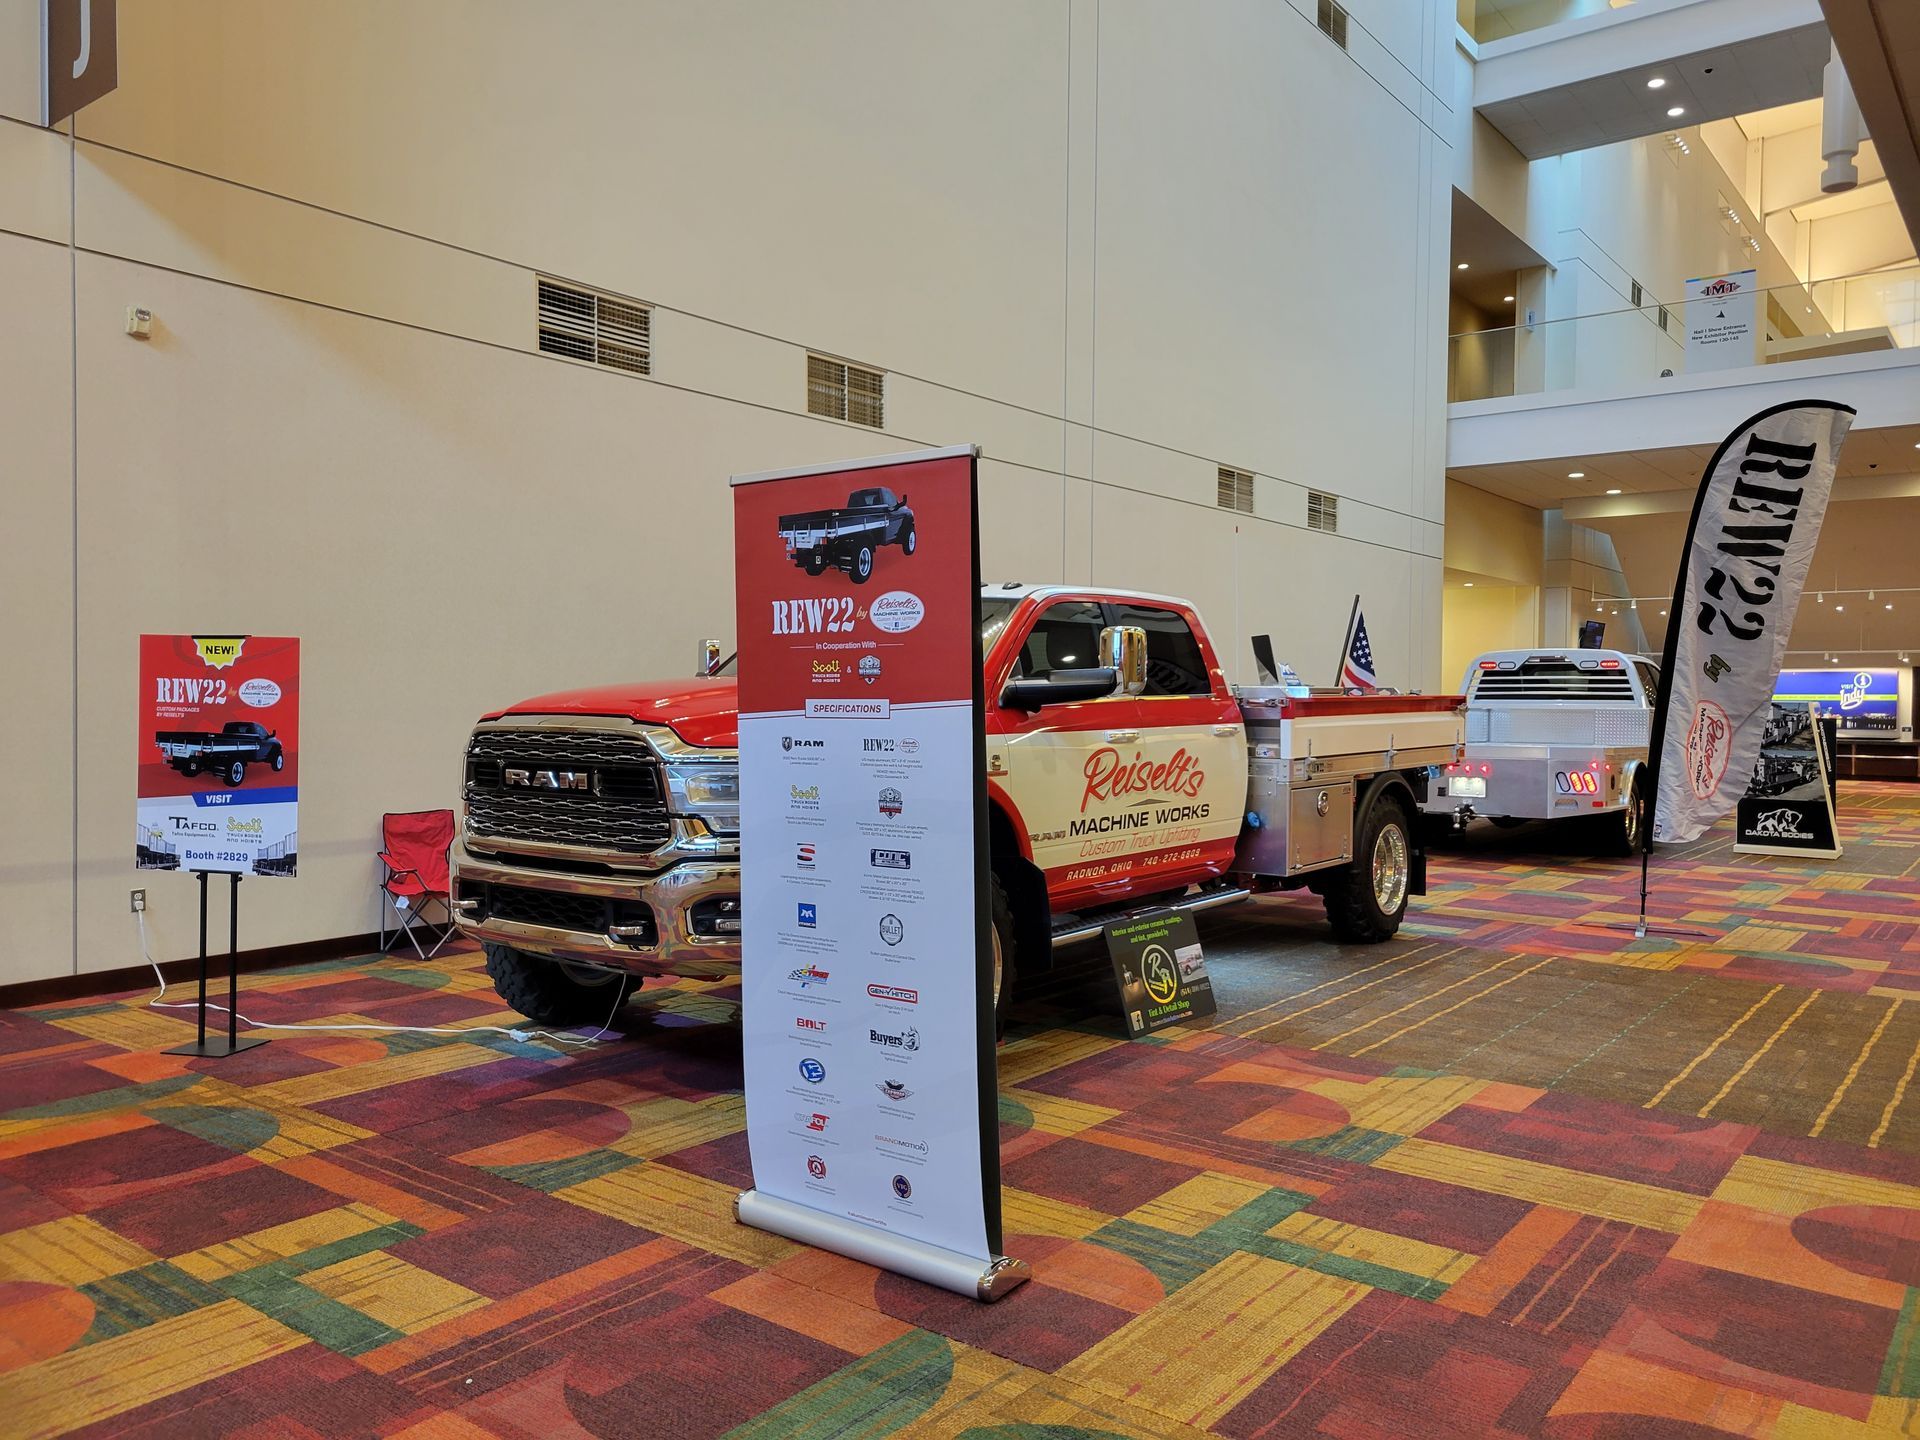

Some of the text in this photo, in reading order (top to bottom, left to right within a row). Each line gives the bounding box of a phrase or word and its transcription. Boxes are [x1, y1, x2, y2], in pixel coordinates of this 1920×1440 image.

[1704, 282, 1736, 296] IMT
[1698, 432, 1817, 641] REW22
[772, 597, 854, 634] REW22
[856, 606, 868, 619] by
[205, 646, 234, 655] NEW!
[823, 642, 860, 650] Cooperation
[156, 678, 226, 704] REW22
[1840, 686, 1864, 710] Indy
[813, 704, 881, 714] SPECIFICATIONS
[863, 738, 894, 751] REW22
[505, 768, 588, 790] RAM
[1080, 747, 1205, 814] Reiselt's
[206, 794, 232, 804] VISIT
[1069, 804, 1210, 837] MACHINE WORKS
[1745, 829, 1814, 840] DAKOTA BODIES
[1079, 826, 1201, 858] Custom Truck Upfitting
[186, 850, 248, 861] Booth #2829
[1066, 848, 1201, 881] RADNOR, OHIO 740-272-6809
[881, 925, 900, 934] BULLET
[1127, 925, 1135, 933] and
[1130, 935, 1138, 943] and
[892, 990, 914, 1000] HITCH
[1148, 1008, 1158, 1017] Tint
[1163, 1002, 1177, 1013] Detail
[1177, 1000, 1190, 1009] Shop
[796, 1018, 826, 1031] BOLT
[870, 1030, 902, 1045] Buyers
[874, 1134, 925, 1151] BRANDMOTION
